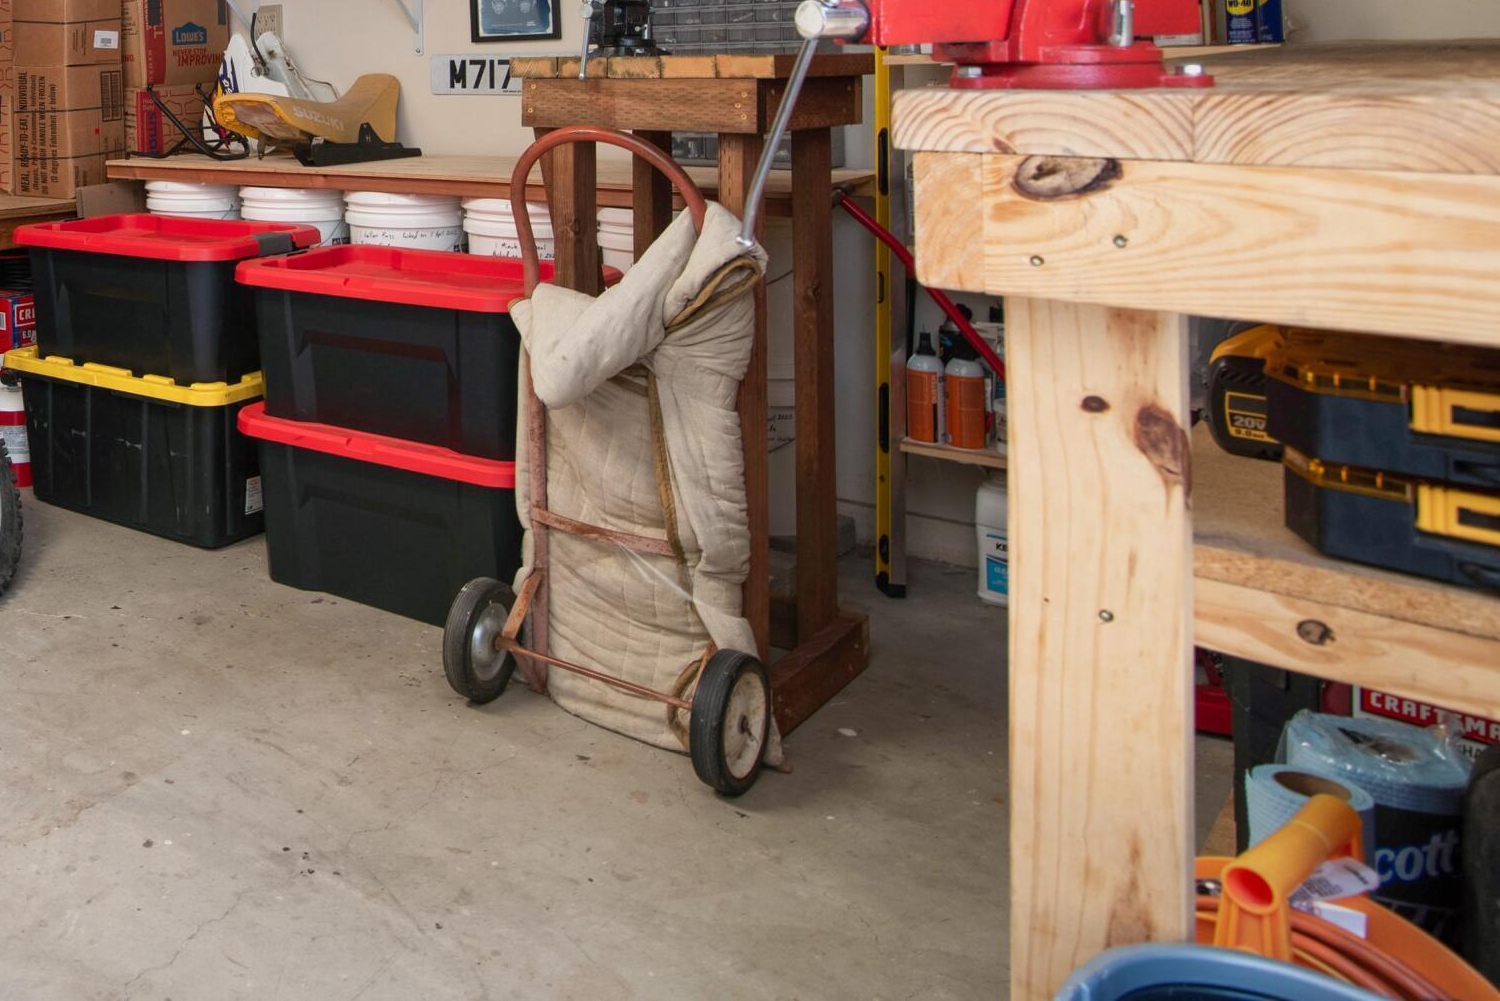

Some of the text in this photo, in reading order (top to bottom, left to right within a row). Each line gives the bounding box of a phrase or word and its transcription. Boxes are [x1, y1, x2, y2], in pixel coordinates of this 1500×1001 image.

[1228, 0, 1251, 8] WD-40
[175, 31, 204, 43] LOWE'S
[449, 59, 511, 89] M717
[293, 105, 344, 131] SUZUKI
[1375, 831, 1458, 883] cott
